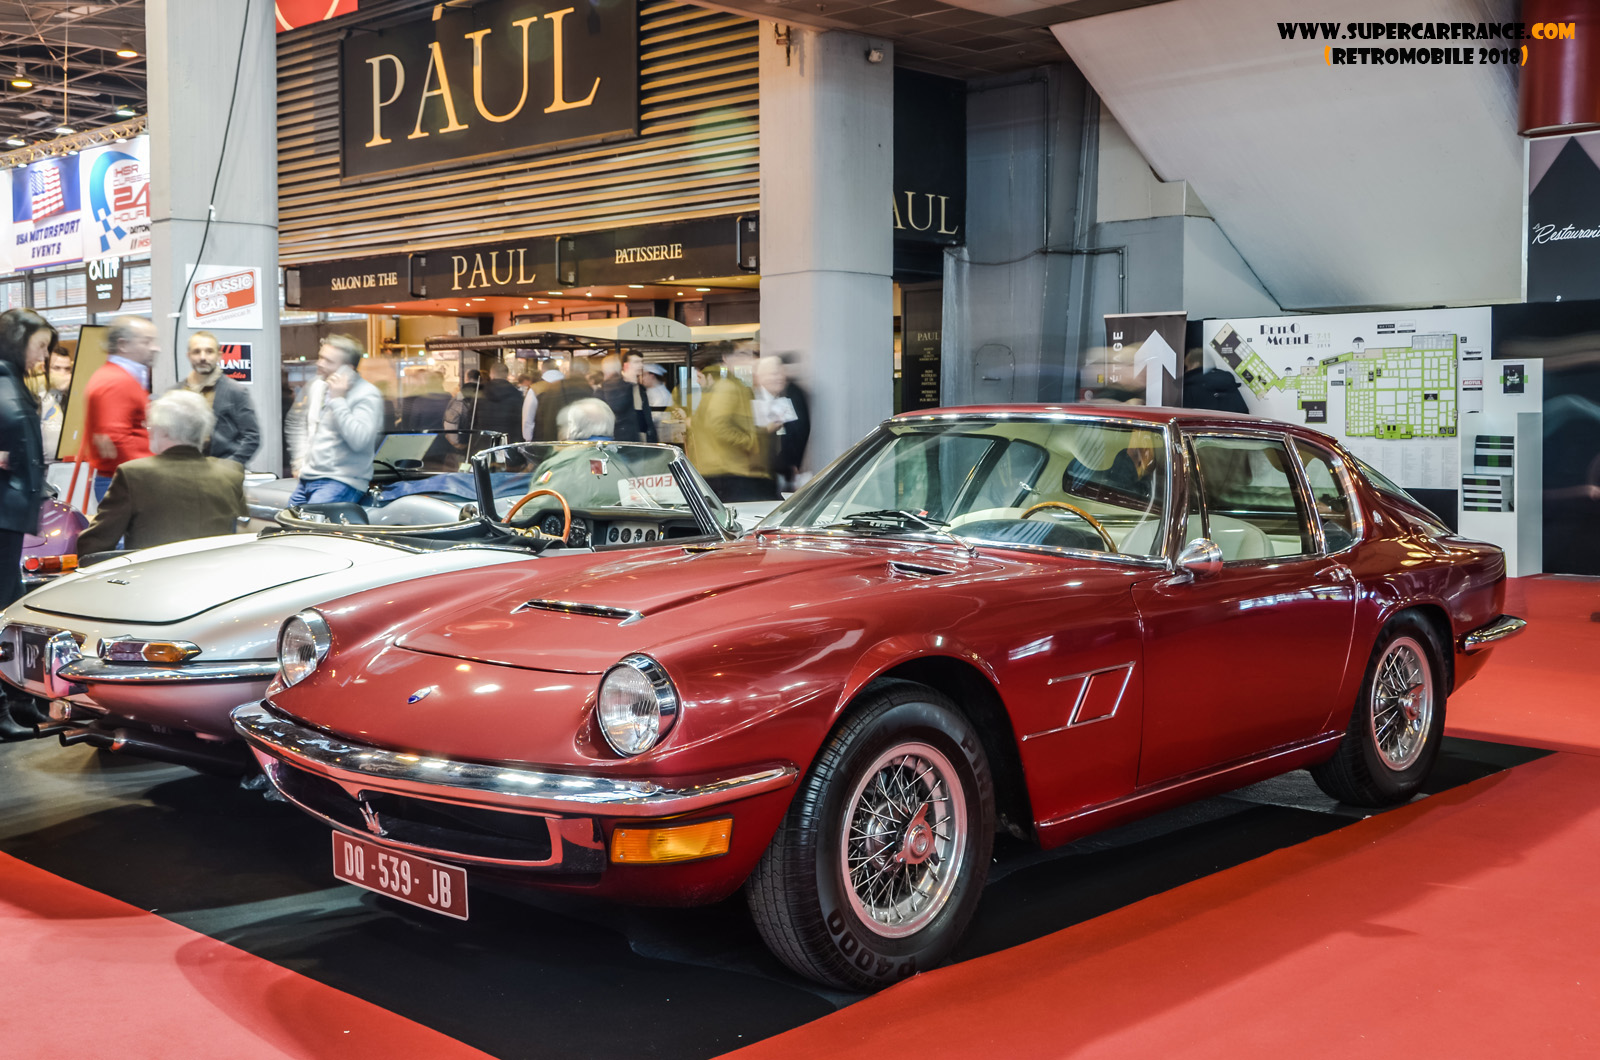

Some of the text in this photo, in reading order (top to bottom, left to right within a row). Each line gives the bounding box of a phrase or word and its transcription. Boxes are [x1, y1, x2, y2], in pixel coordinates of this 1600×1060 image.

[364, 6, 602, 149] PAUL
[113, 182, 150, 217] 24
[29, 218, 81, 243] MOTORSPORT
[32, 242, 62, 258] EVENTS
[614, 243, 683, 264] PATISSERIE
[451, 248, 536, 291] PAUL
[196, 274, 253, 298] CLASSIC
[331, 272, 398, 291] SALON DE THE
[196, 295, 227, 313] CAR
[635, 322, 676, 339] PAUL
[917, 332, 940, 341] PAUL
